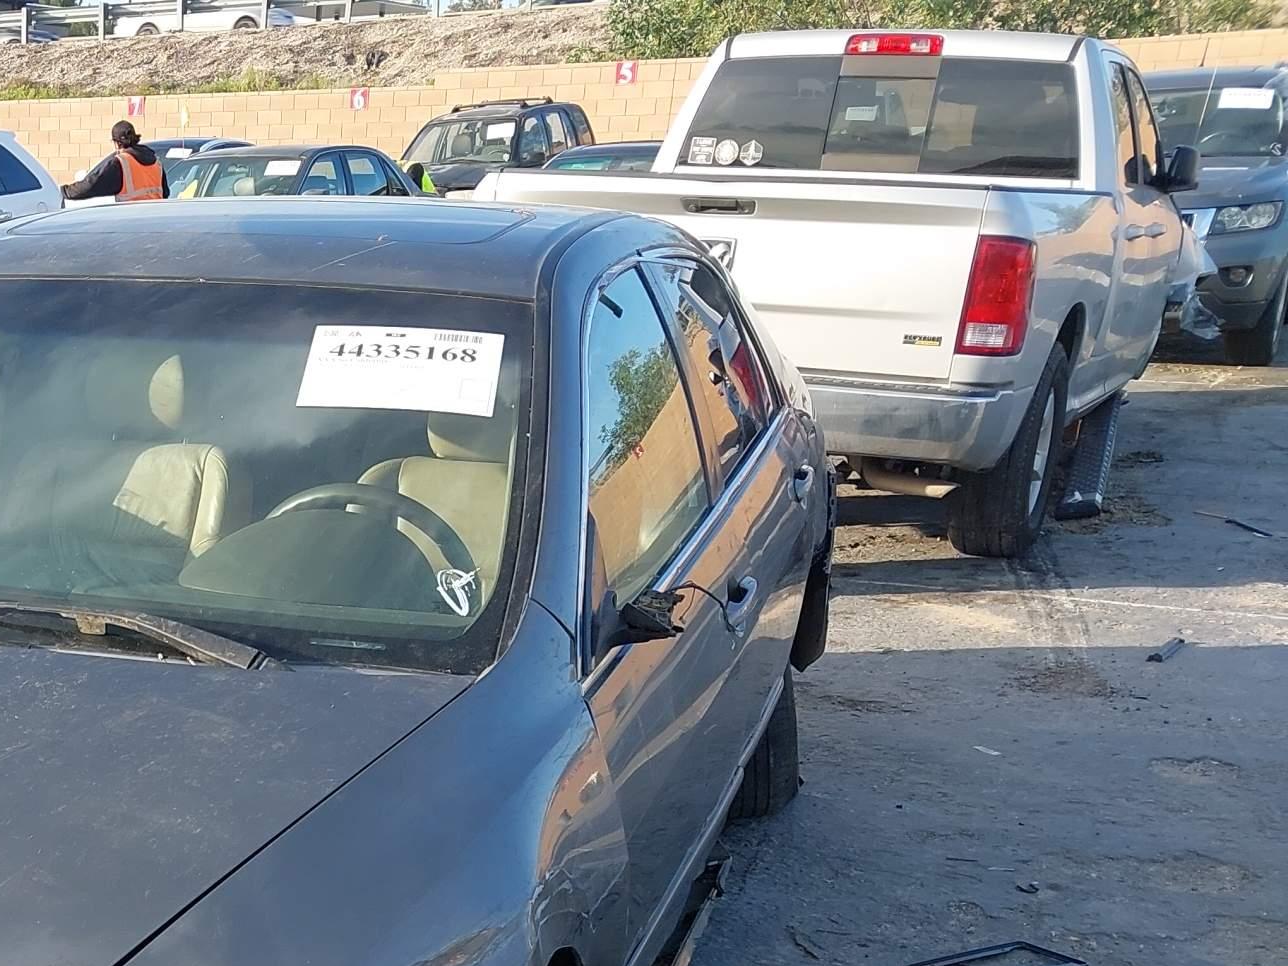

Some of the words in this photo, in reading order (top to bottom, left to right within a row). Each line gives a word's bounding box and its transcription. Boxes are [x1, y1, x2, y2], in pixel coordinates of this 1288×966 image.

[618, 62, 634, 85] 5
[130, 98, 143, 116] 7
[352, 88, 366, 109] 6
[329, 343, 478, 363] 44335168
